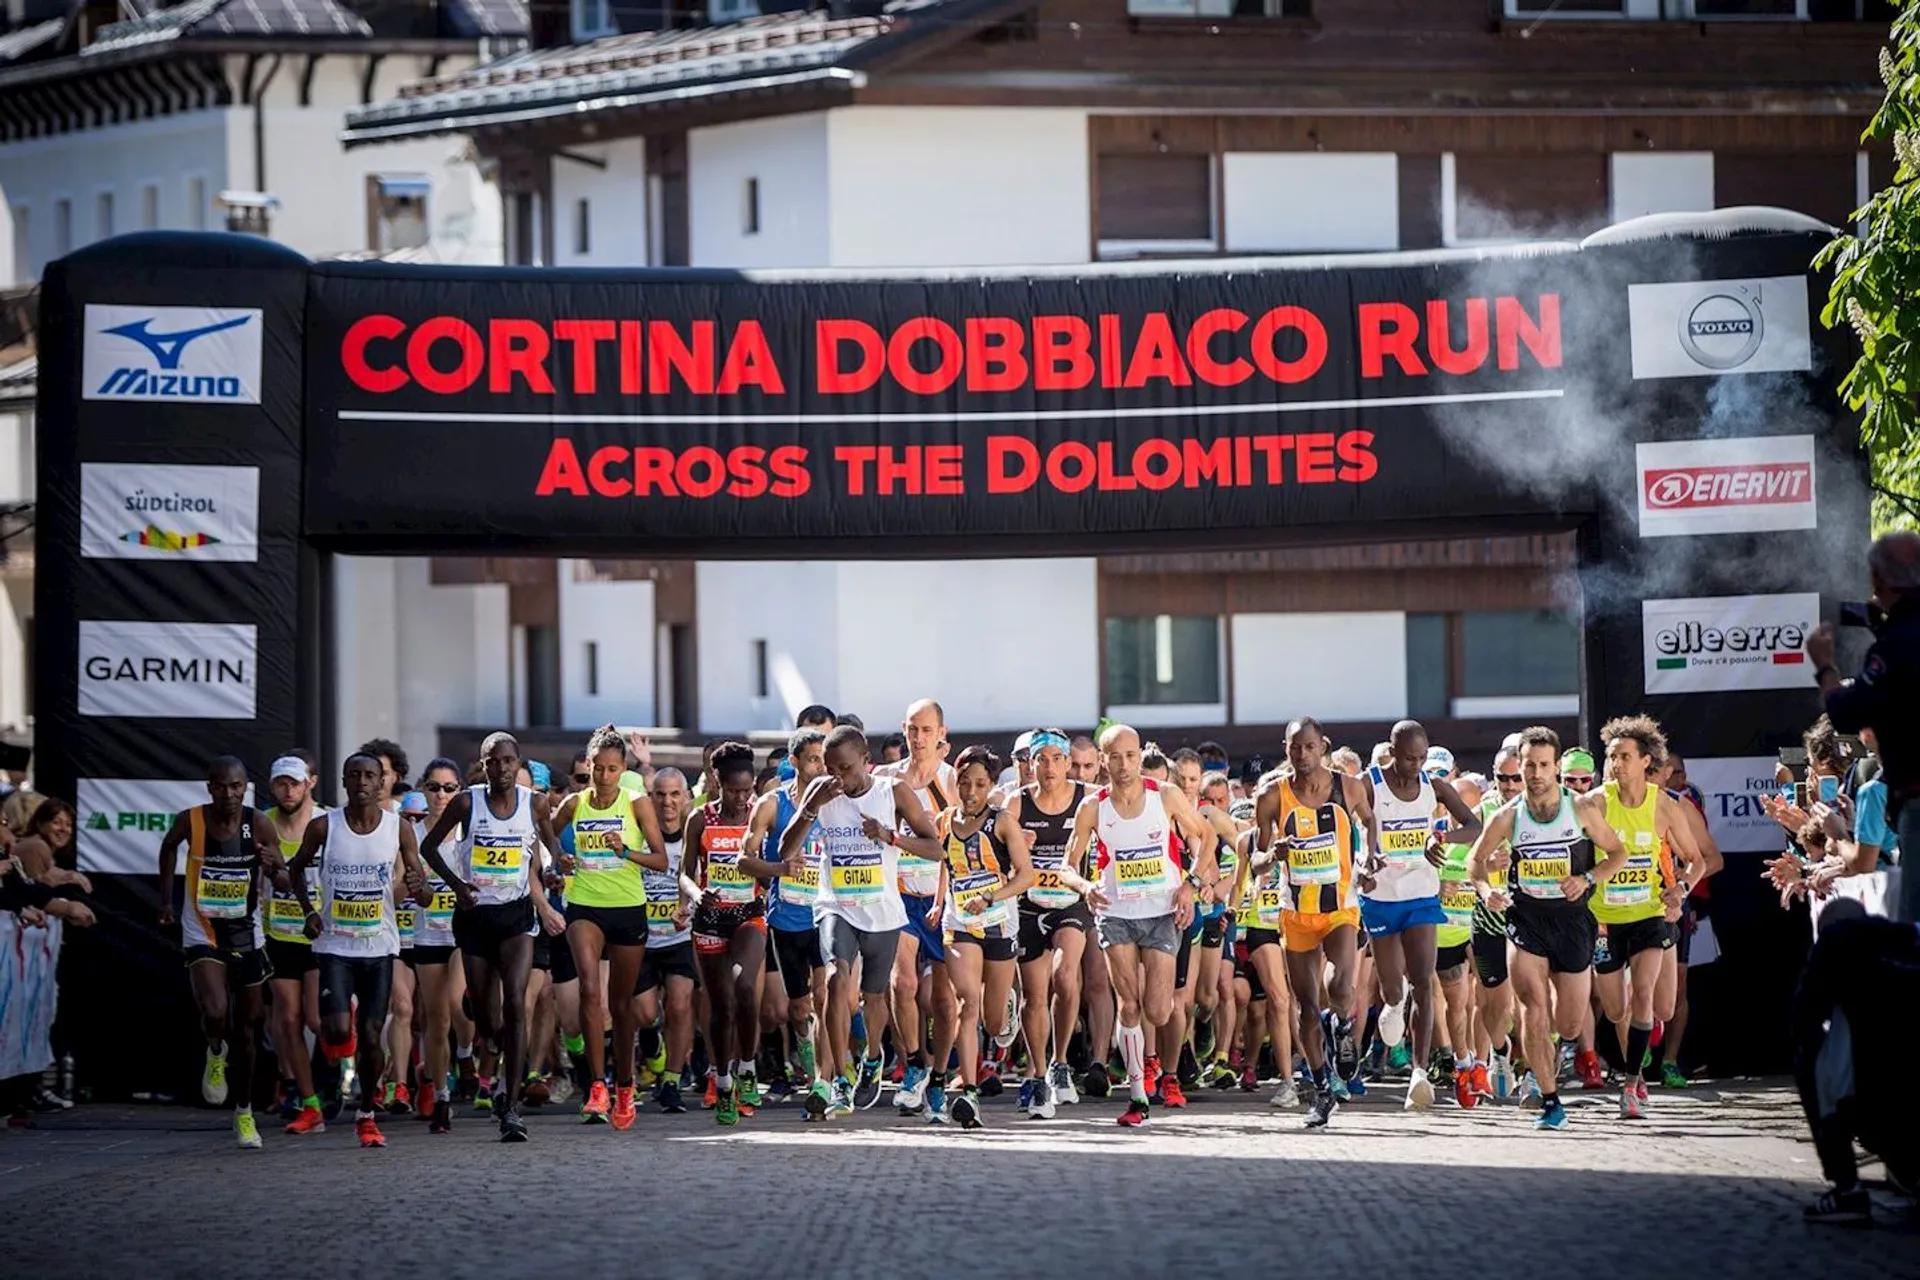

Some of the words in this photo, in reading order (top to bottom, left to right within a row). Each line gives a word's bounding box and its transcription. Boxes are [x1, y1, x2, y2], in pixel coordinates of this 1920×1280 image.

[1690, 321, 1752, 334] VOLVO
[341, 314, 786, 395] CORTINA
[816, 305, 1328, 395] DOBBIACO
[1358, 293, 1563, 378] RUN
[97, 367, 240, 397] MIZUNO
[535, 438, 812, 498] ACROSS
[834, 445, 965, 496] THE
[986, 430, 1379, 494] DOLOMITES
[1692, 468, 1809, 503] ENERVIT
[85, 656, 243, 684] GARMIN
[1729, 655, 1768, 668] passione
[1746, 777, 1781, 791] Fon
[1714, 793, 1778, 818] Tav
[117, 811, 176, 832] PIR
[1389, 832, 1426, 849] KURGAT
[486, 851, 508, 866] 24
[1294, 849, 1333, 866] MARITIM
[844, 868, 872, 885] GITAU
[1120, 861, 1162, 879] BOUDALIA
[1523, 862, 1567, 878] PALAMINI
[1608, 870, 1648, 885] 2023
[1039, 873, 1062, 888] 22
[1262, 893, 1280, 906] F3
[338, 903, 381, 919] MWANGI
